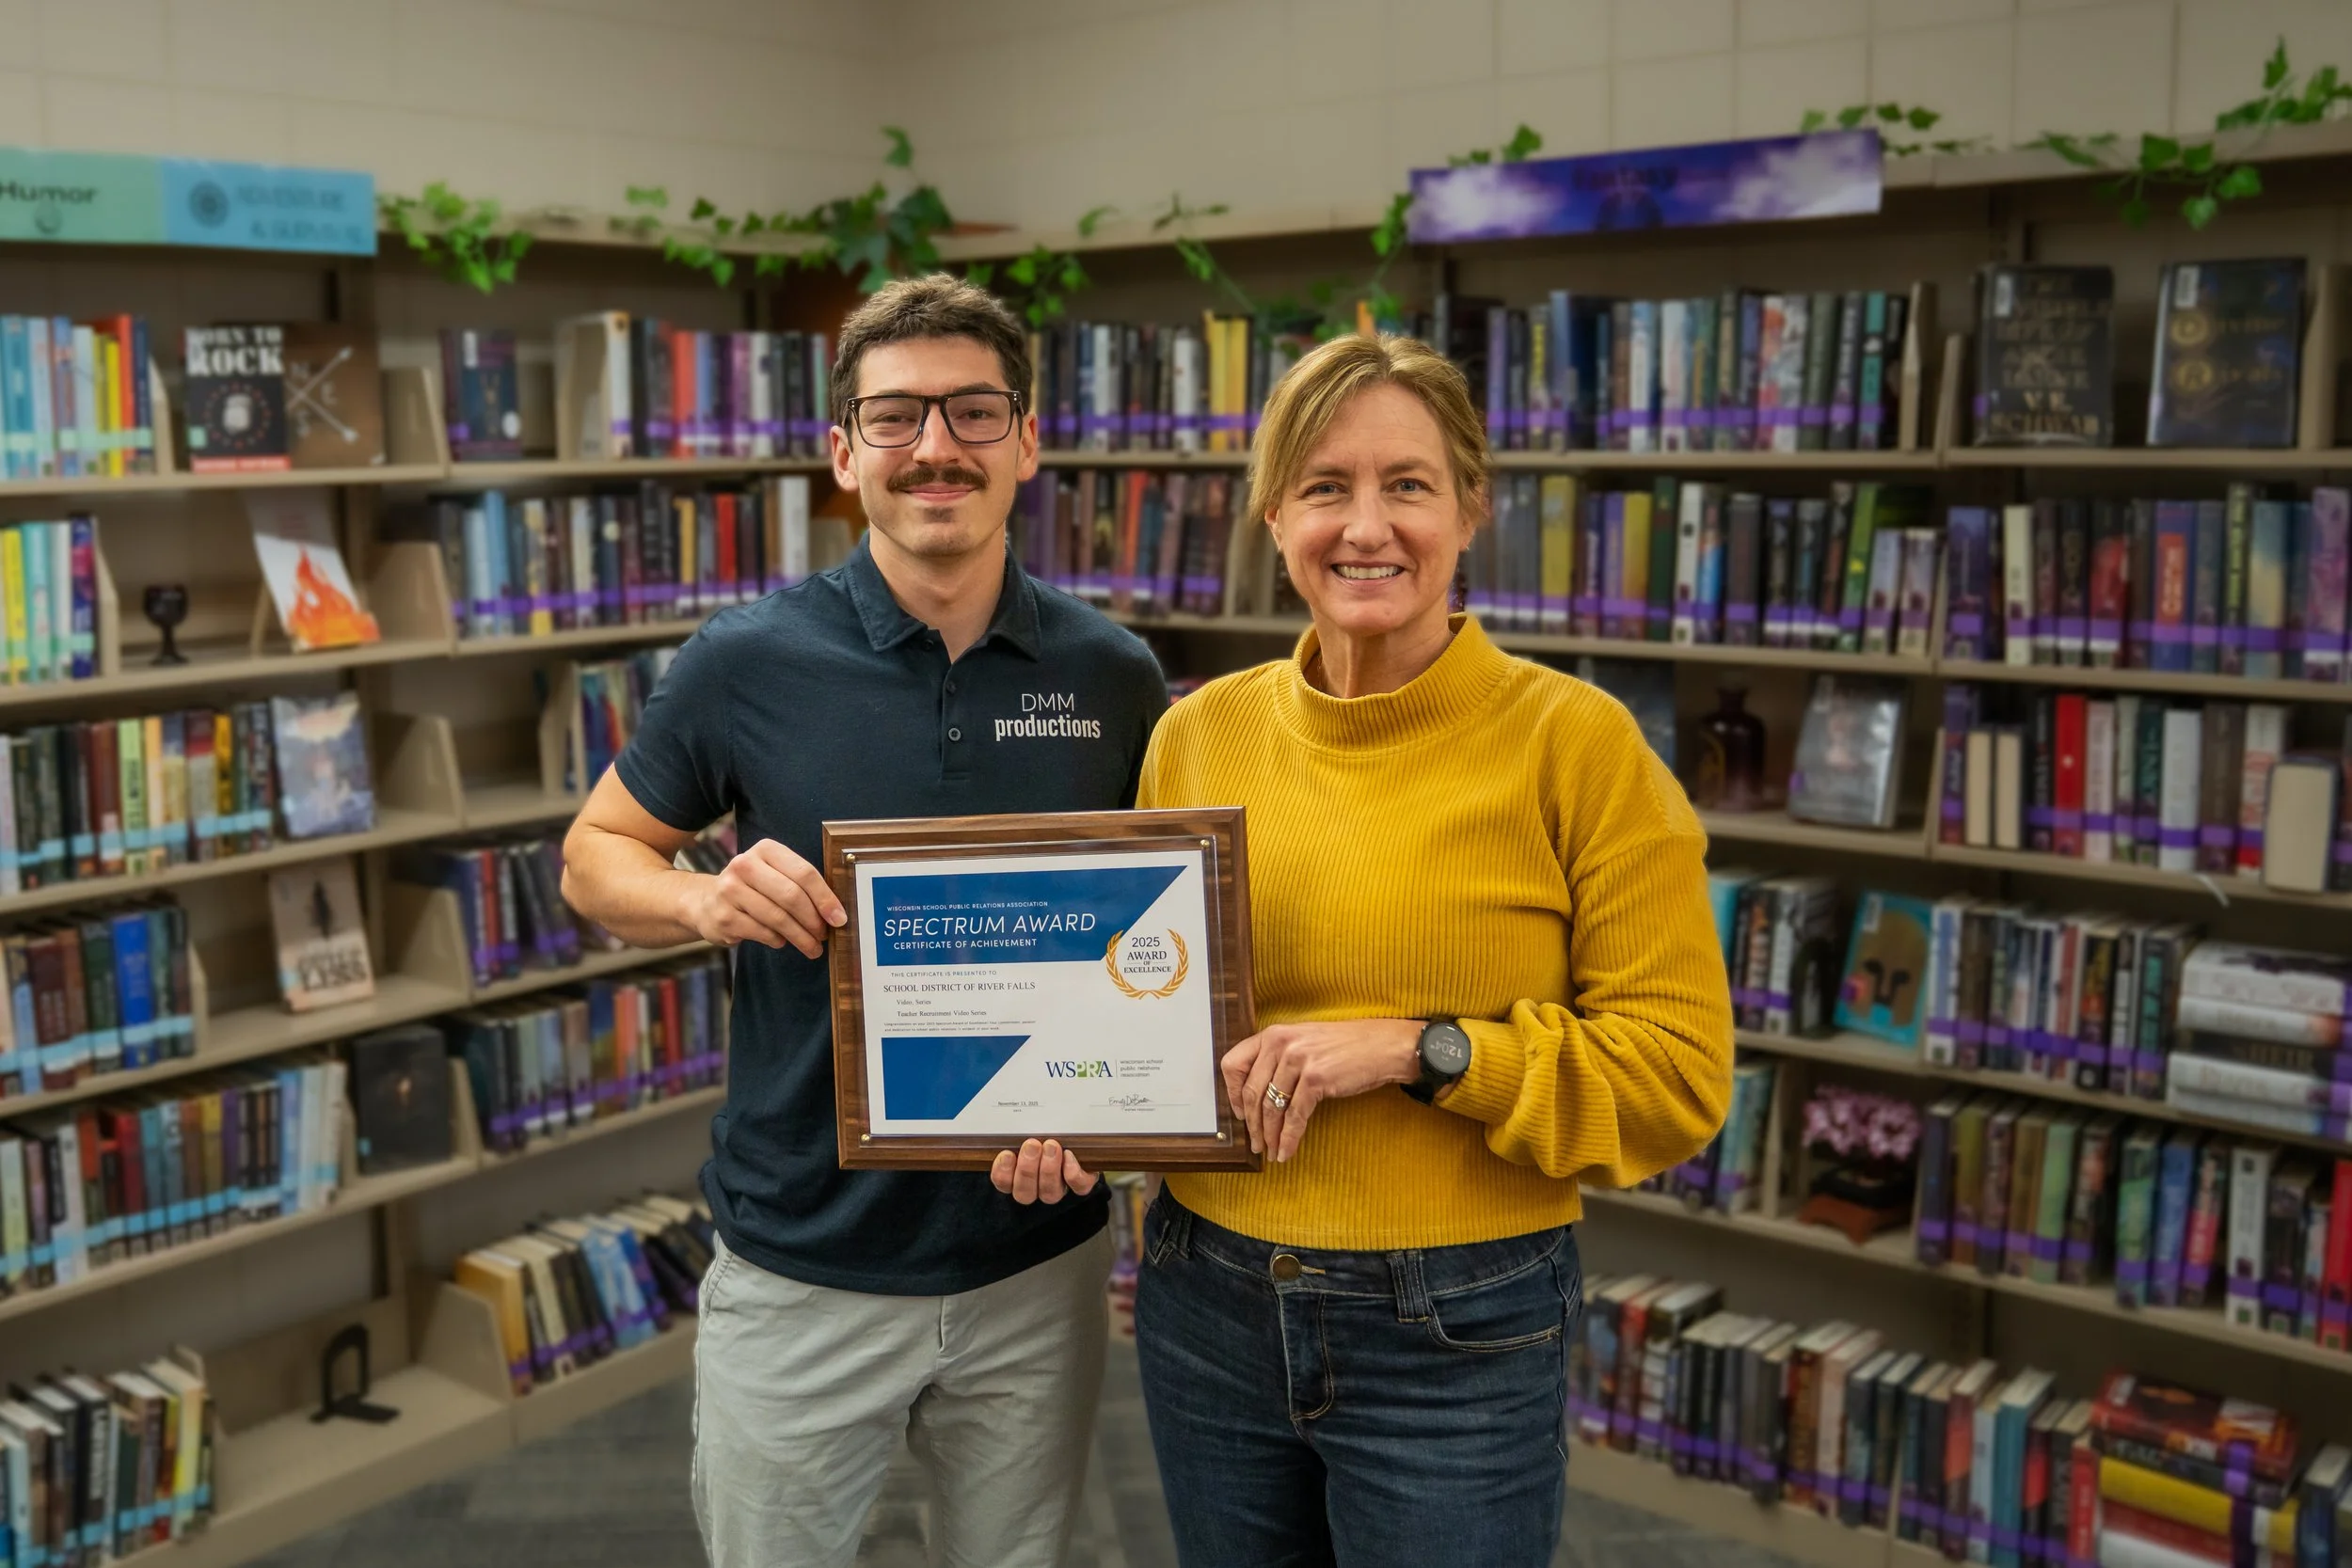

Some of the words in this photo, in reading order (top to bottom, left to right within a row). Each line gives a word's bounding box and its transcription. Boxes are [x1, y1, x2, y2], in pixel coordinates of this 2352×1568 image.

[0, 180, 98, 204] Humor
[1021, 693, 1074, 712] DMM
[994, 714, 1101, 742] productions
[884, 916, 1005, 937] SPECTRUM
[1013, 913, 1096, 933] AWARD
[894, 941, 952, 950] CERTIFICATE
[970, 938, 1037, 948] ACHIEVEMENT
[1132, 937, 1160, 948] 2025
[1127, 951, 1167, 960] AWARD
[921, 983, 961, 992] DISTRICT
[1007, 982, 1036, 990] FALLS
[1045, 1061, 1113, 1078] WSPRA
